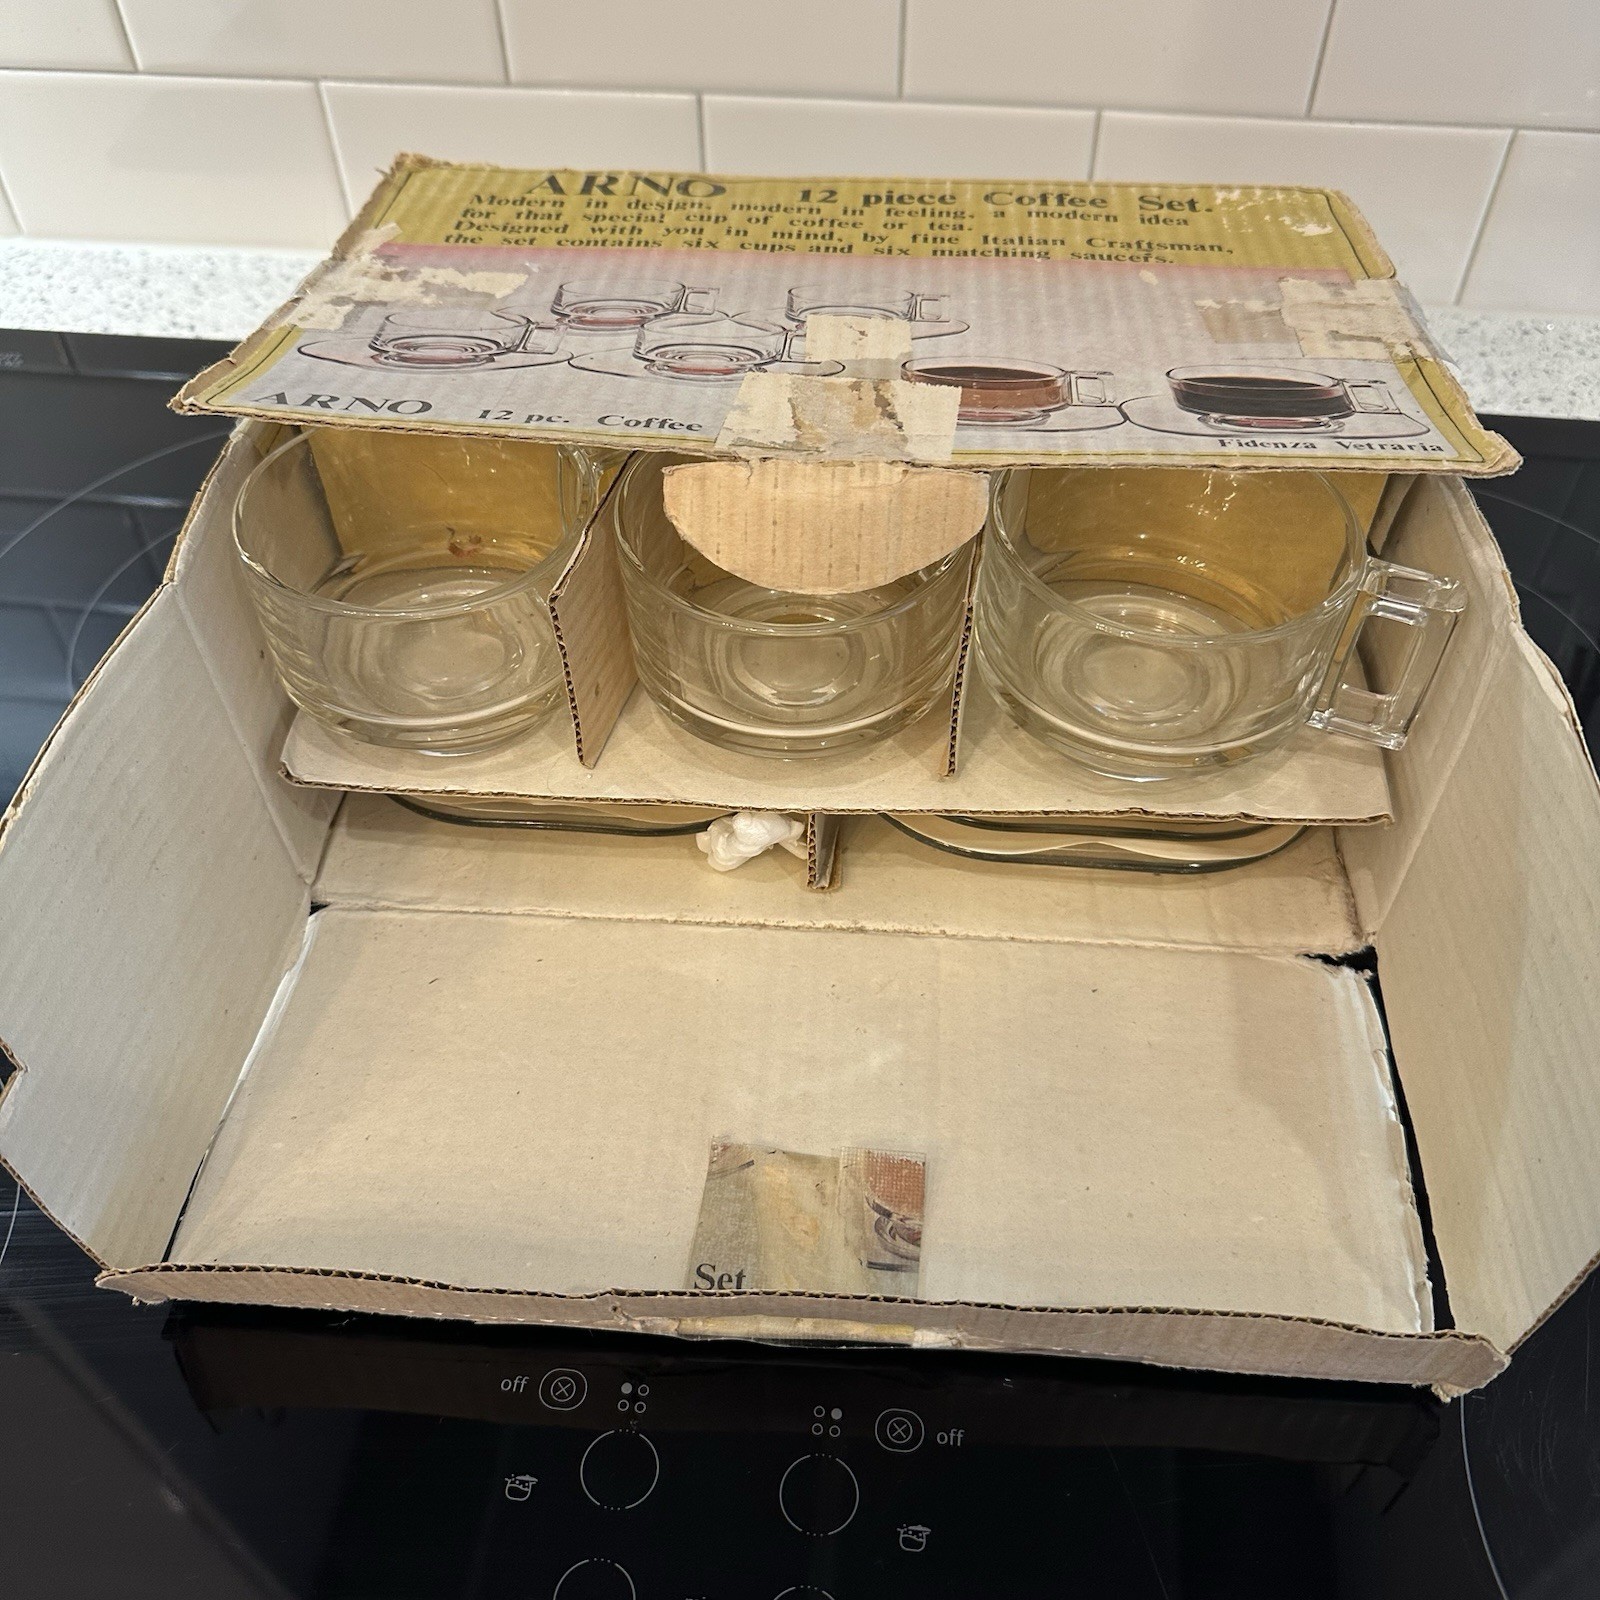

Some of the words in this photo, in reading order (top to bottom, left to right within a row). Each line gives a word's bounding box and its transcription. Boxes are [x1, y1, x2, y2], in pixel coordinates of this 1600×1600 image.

[527, 174, 727, 198] ARNO
[800, 189, 839, 204] 12
[862, 190, 957, 207] piece
[983, 190, 1108, 209] Coffee
[1138, 194, 1213, 214] Set.
[461, 208, 496, 219] for
[515, 210, 563, 221] that
[582, 212, 666, 224] special
[685, 214, 728, 225] cup
[746, 215, 773, 225] of
[788, 217, 864, 230] coffee
[882, 221, 908, 231] or
[928, 221, 974, 232] tea.
[470, 194, 565, 208] Modern
[585, 198, 608, 209] in
[731, 203, 821, 215] modern
[842, 206, 865, 216] in
[993, 209, 1006, 219] a
[1027, 209, 1119, 223] modern
[1139, 214, 1190, 227] idea
[444, 234, 483, 245] the
[501, 236, 537, 247] set
[556, 236, 663, 248] contains
[681, 238, 720, 250] six
[739, 241, 796, 254] cups
[808, 245, 854, 255] and
[873, 246, 911, 256] six
[932, 247, 1050, 260] matching
[1070, 251, 1174, 264] saucers.
[454, 221, 569, 235] Designed
[590, 226, 643, 236] with
[662, 226, 705, 237] you
[725, 227, 748, 238] in
[771, 229, 844, 243] mind,
[862, 232, 889, 244] by
[911, 233, 960, 245] fine
[981, 234, 1066, 247] Italian
[1086, 237, 1234, 255] Craftsman,
[254, 392, 434, 416] ARNO
[478, 409, 512, 421] 12
[523, 414, 570, 425] pc.
[597, 413, 704, 433] Coffee
[1218, 438, 1317, 450] Fidenza
[1335, 440, 1444, 453] Vetraria
[694, 1262, 747, 1290] Set
[500, 1375, 530, 1394] off
[936, 1428, 965, 1447] off
